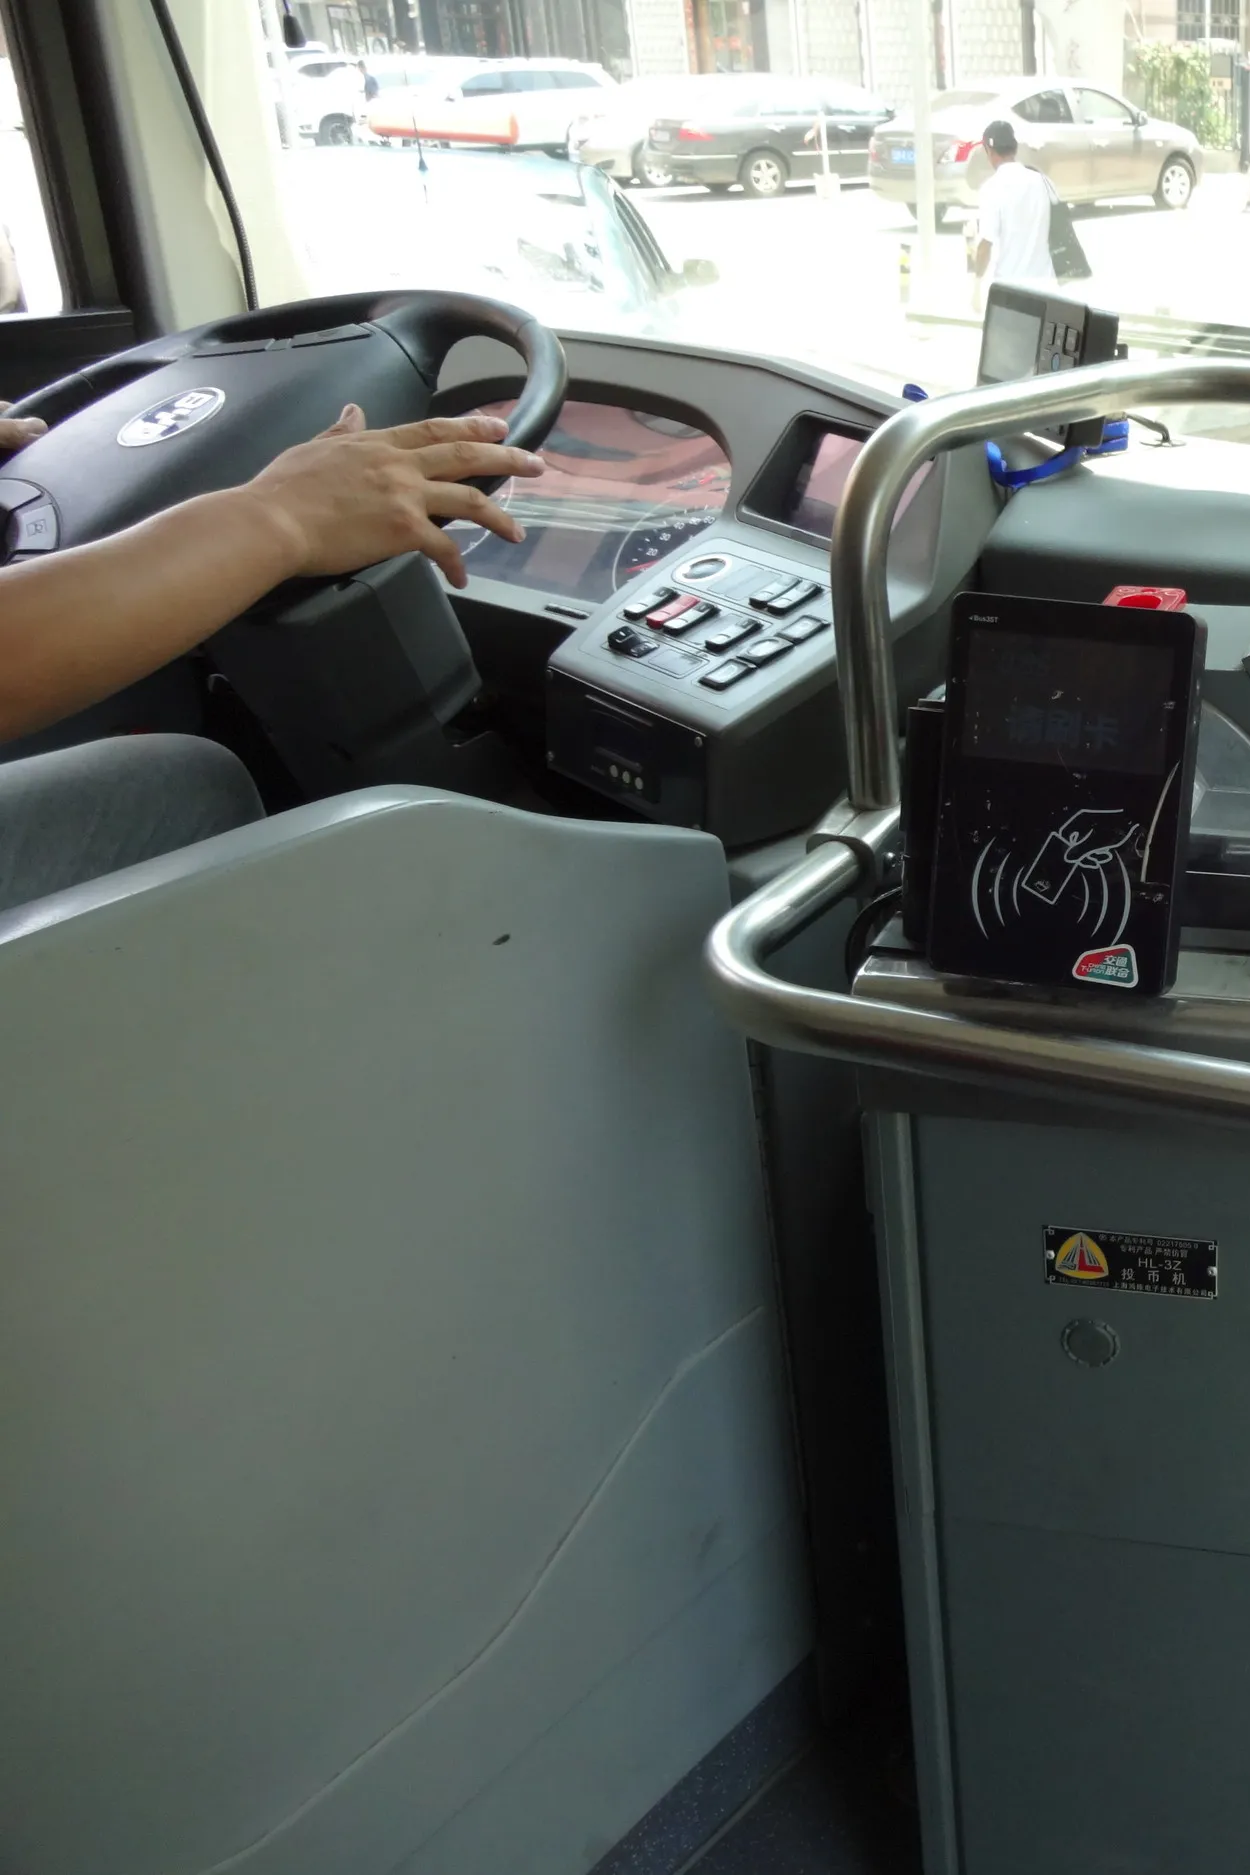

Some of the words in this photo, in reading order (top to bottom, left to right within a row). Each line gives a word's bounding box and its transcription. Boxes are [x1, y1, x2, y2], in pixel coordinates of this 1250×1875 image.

[646, 547, 658, 556] 20
[1103, 955, 1128, 967] 交通
[1105, 965, 1130, 978] 联合
[1138, 1258, 1182, 1271] HL-3Z
[1121, 1268, 1187, 1286] 投币机
